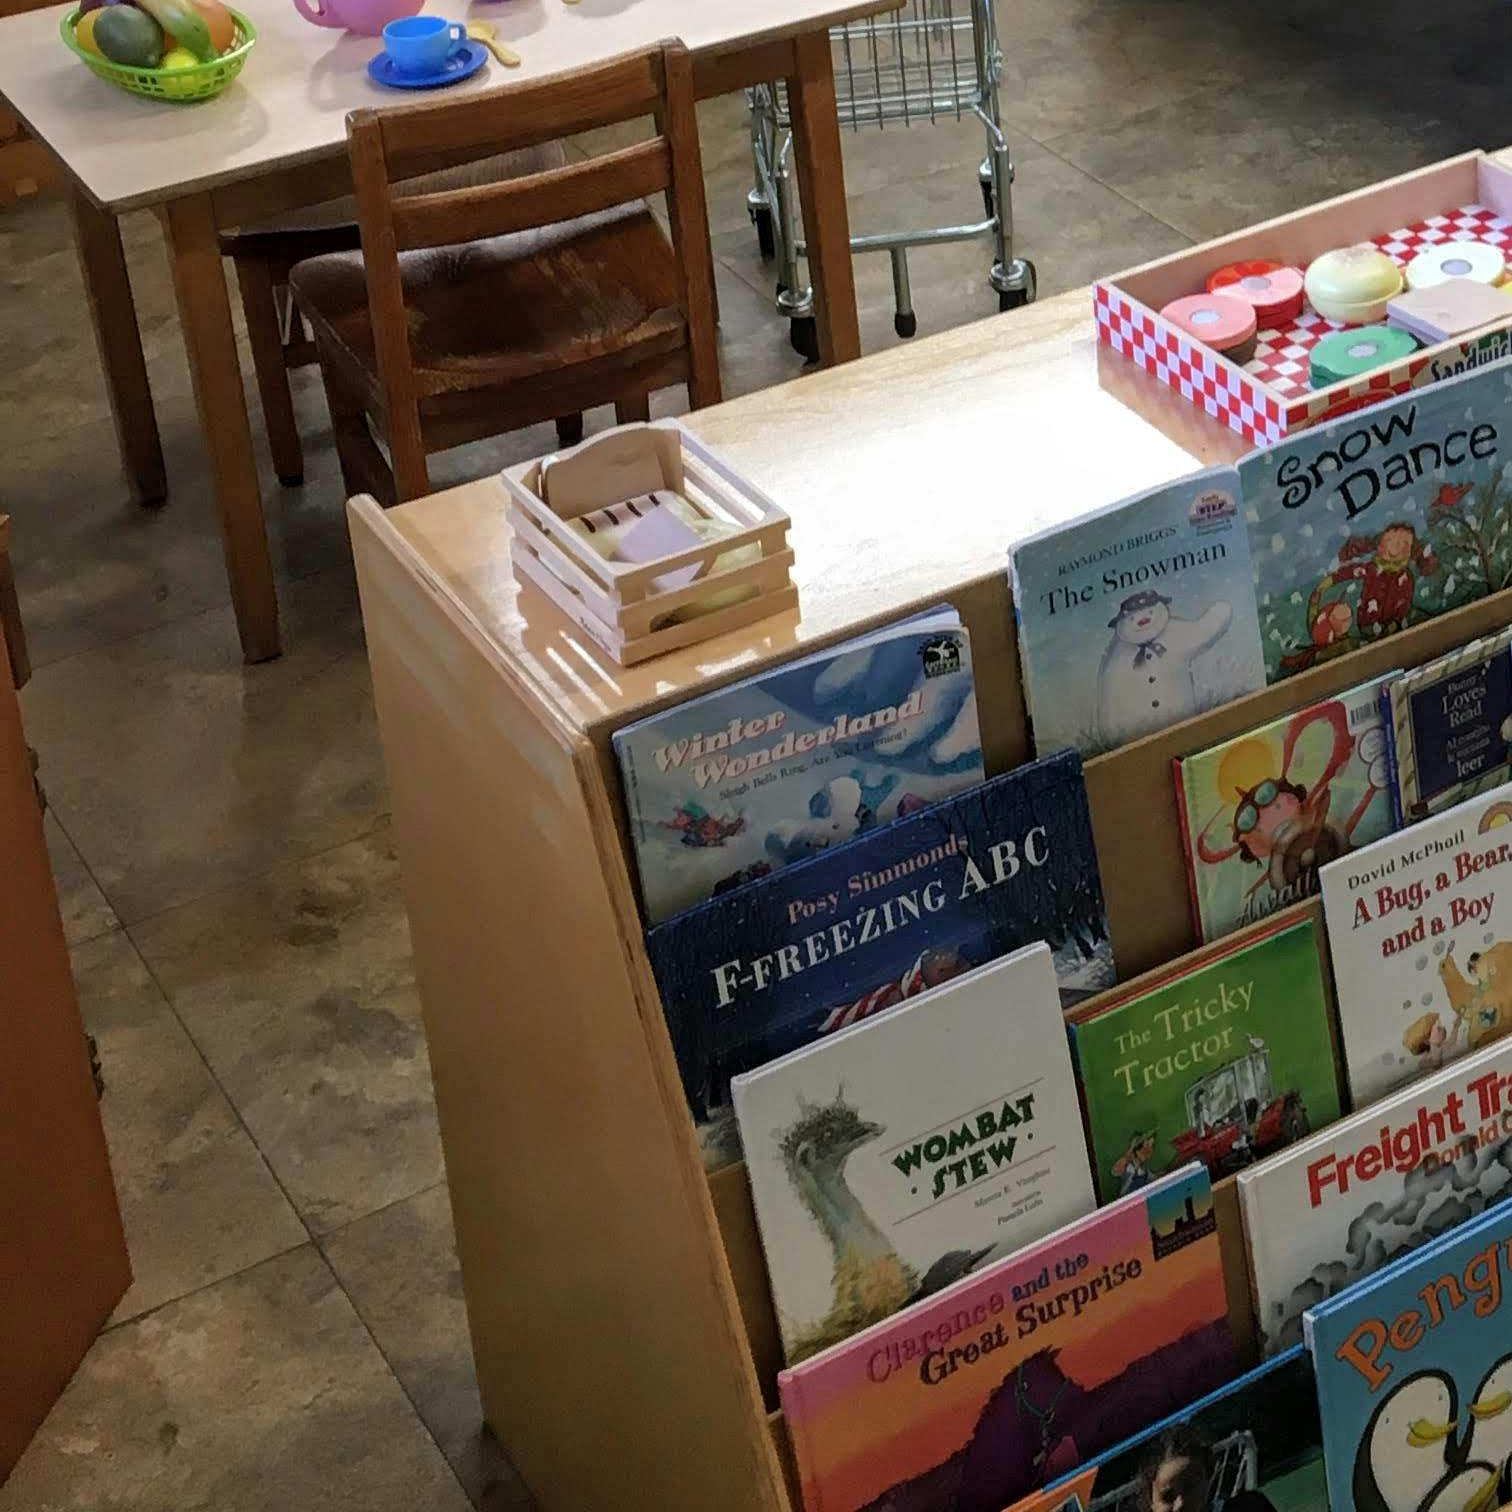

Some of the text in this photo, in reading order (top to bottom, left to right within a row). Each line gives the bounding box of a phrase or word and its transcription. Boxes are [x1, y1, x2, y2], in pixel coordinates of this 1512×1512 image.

[1276, 404, 1417, 509] Snow
[1334, 423, 1498, 521] Dance
[1039, 541, 1227, 616] The Snowman
[1057, 526, 1177, 577] RAYMOND BRIGGS
[1441, 685, 1488, 715] Loves
[1449, 700, 1483, 728] Read
[651, 709, 787, 775] Winter
[690, 690, 928, 790] Wonderland
[787, 832, 970, 925] Posy Simmonds
[1347, 828, 1466, 891] David McPhail
[709, 823, 1051, 1010] F-FREEZING ABC
[1351, 896, 1374, 931] A
[1373, 878, 1432, 920] Bug,
[1434, 871, 1451, 892] a
[1380, 891, 1496, 959] and a Boy
[1113, 980, 1255, 1055] The Tricky
[1113, 1026, 1234, 1098] Tractor
[890, 1092, 1036, 1179] WOMBAT
[931, 1135, 1019, 1201] STEW
[1306, 1091, 1467, 1210] Freight
[1422, 1120, 1500, 1177] Donald
[866, 1250, 1091, 1384] Clarence and the
[919, 1254, 1144, 1386] Great Surprise
